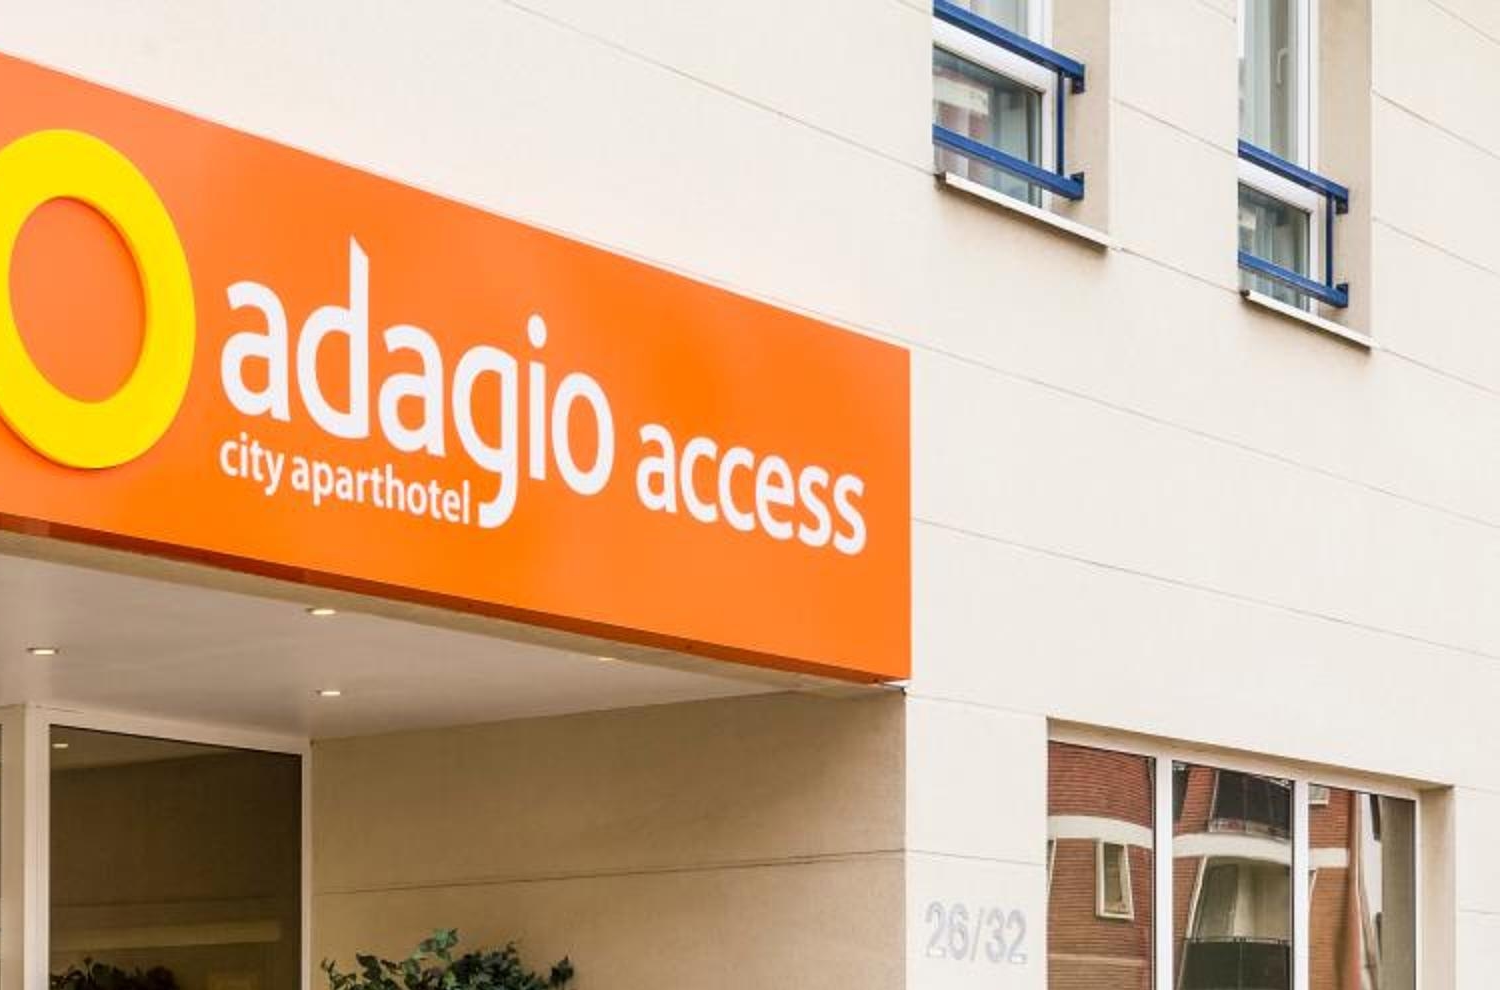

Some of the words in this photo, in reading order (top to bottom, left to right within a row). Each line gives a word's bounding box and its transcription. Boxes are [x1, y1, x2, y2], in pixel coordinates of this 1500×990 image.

[220, 236, 615, 529] adagio
[635, 422, 868, 556] access
[219, 432, 286, 496] city
[291, 456, 470, 525] aparthotel
[925, 901, 1028, 964] 26/32
